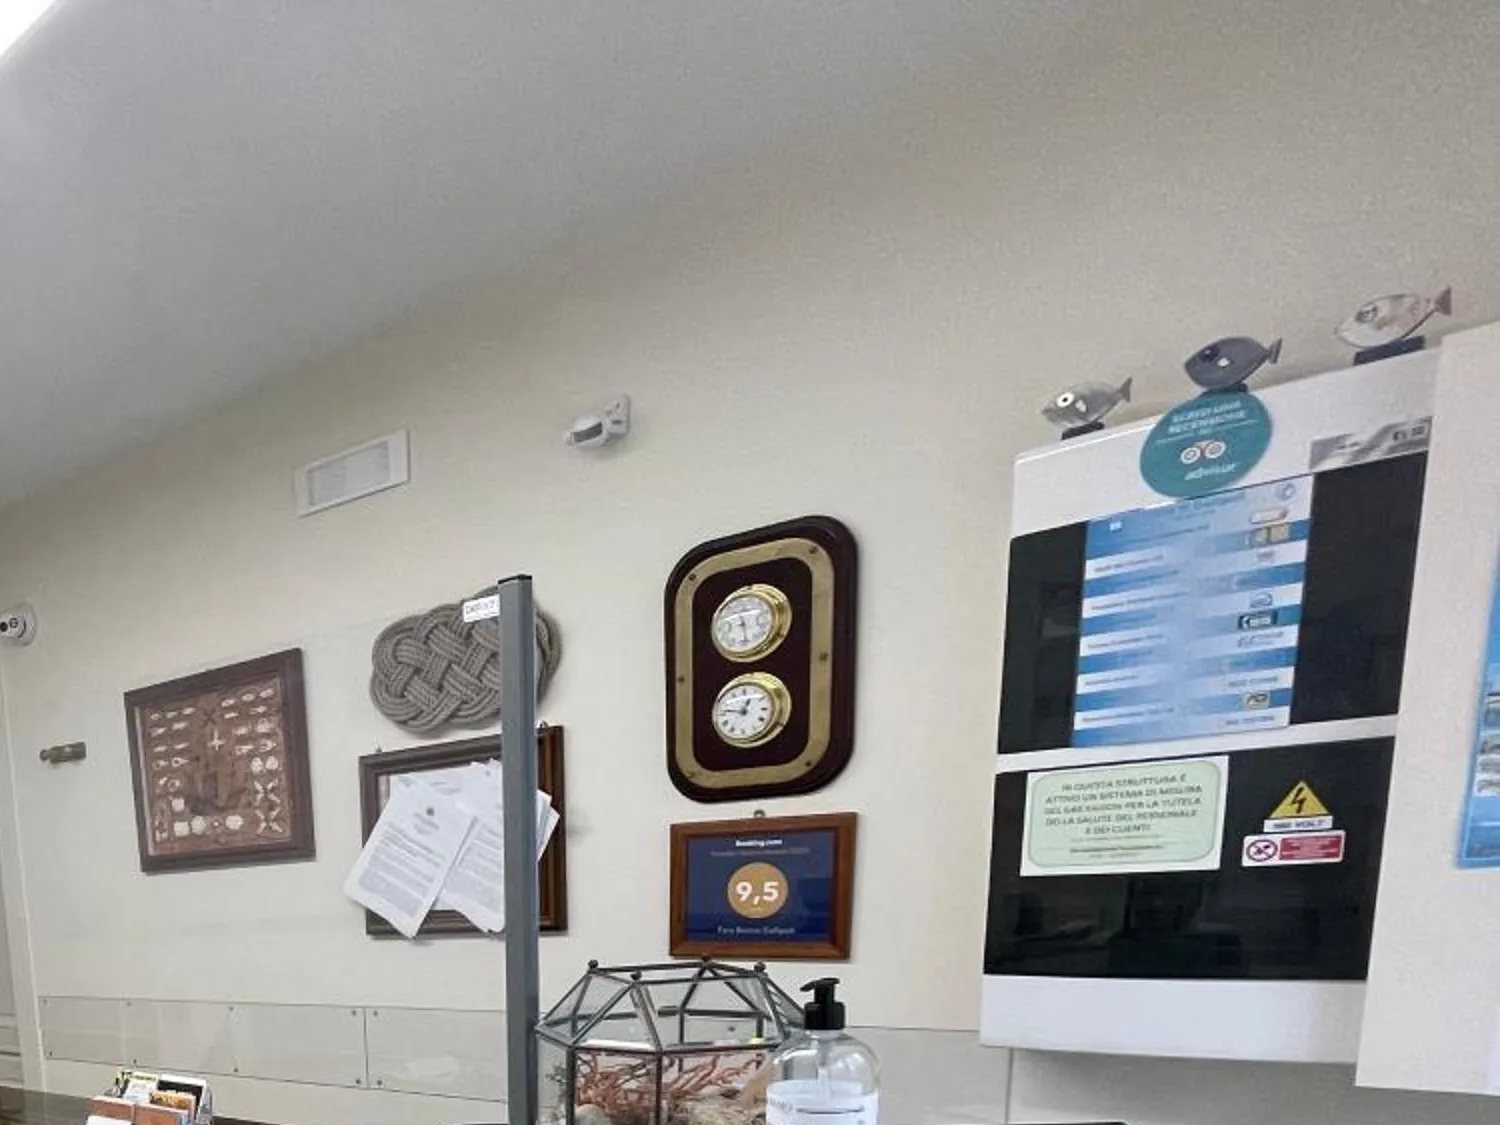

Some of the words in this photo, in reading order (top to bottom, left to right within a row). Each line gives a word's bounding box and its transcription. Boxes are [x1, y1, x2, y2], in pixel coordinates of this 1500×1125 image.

[1115, 774, 1177, 787] STRUTTURA
[1099, 789, 1143, 801] SISTEMA
[1124, 801, 1144, 810] PER
[1145, 799, 1159, 809] LA
[1111, 822, 1151, 834] CLIENTI
[735, 881, 780, 906] 9,5
